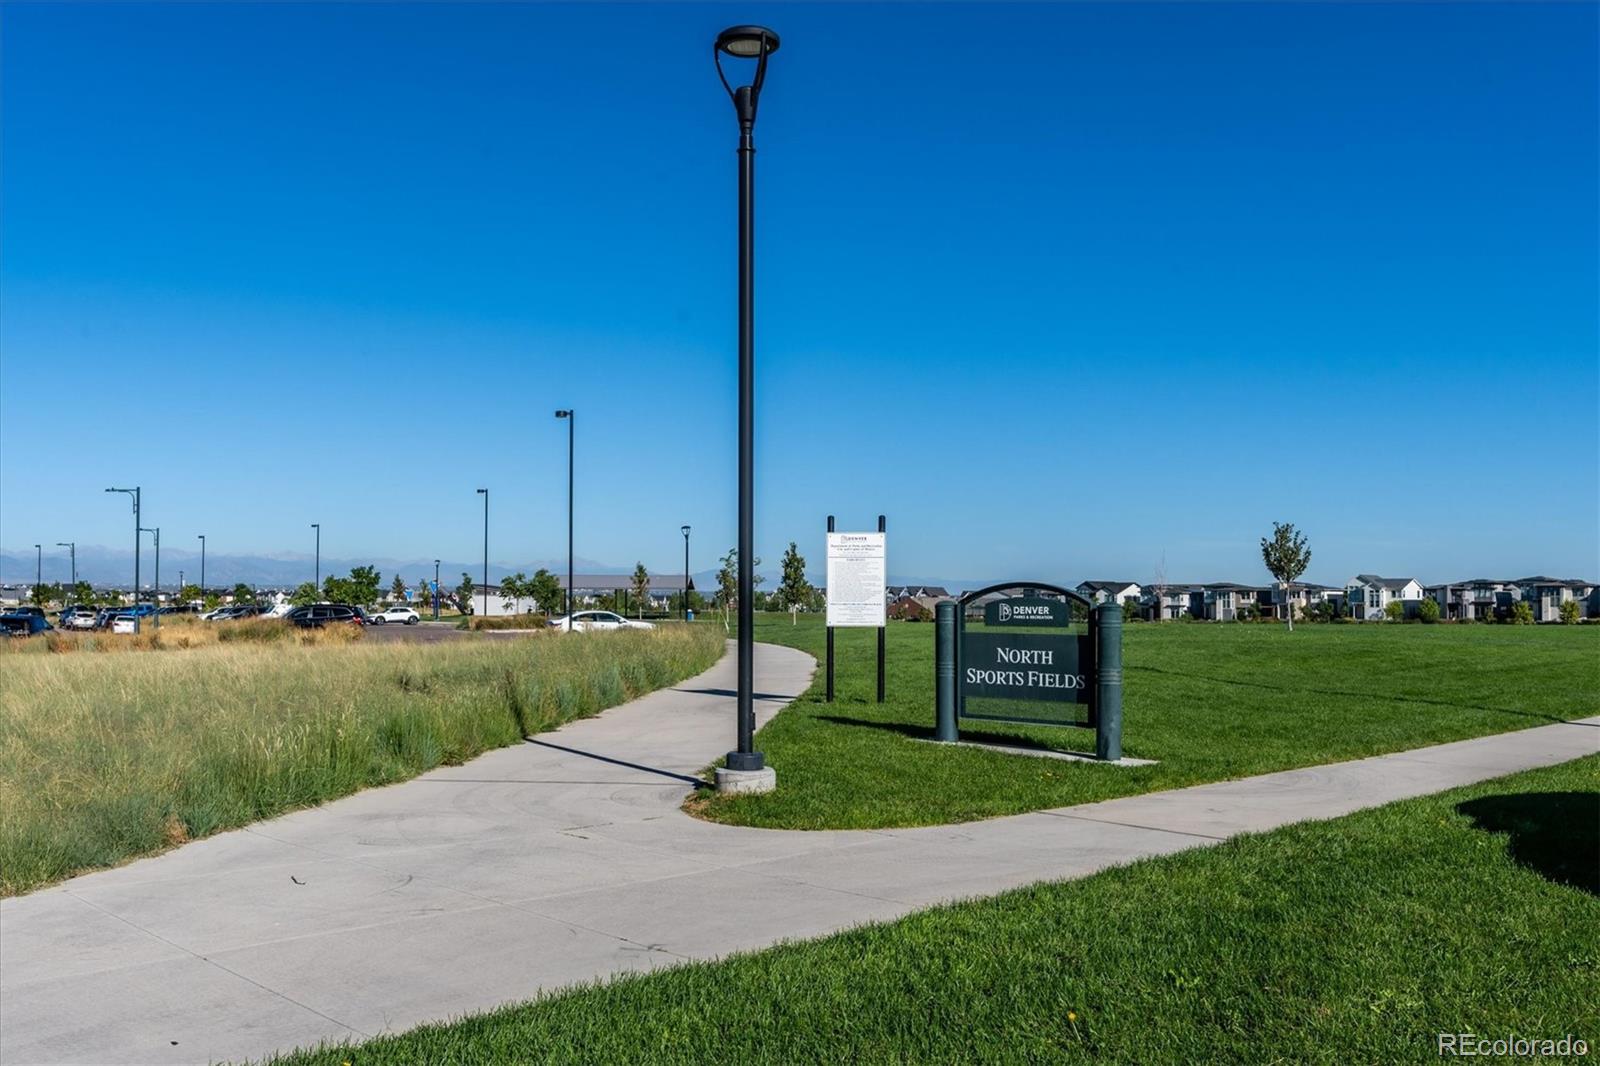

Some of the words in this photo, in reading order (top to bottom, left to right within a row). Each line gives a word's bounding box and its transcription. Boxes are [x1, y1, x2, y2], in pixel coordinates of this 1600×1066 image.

[1013, 606, 1050, 615] DENVER
[996, 647, 1054, 665] NORTH
[966, 667, 1025, 686] SPORTS
[1027, 671, 1086, 689] FIELDS
